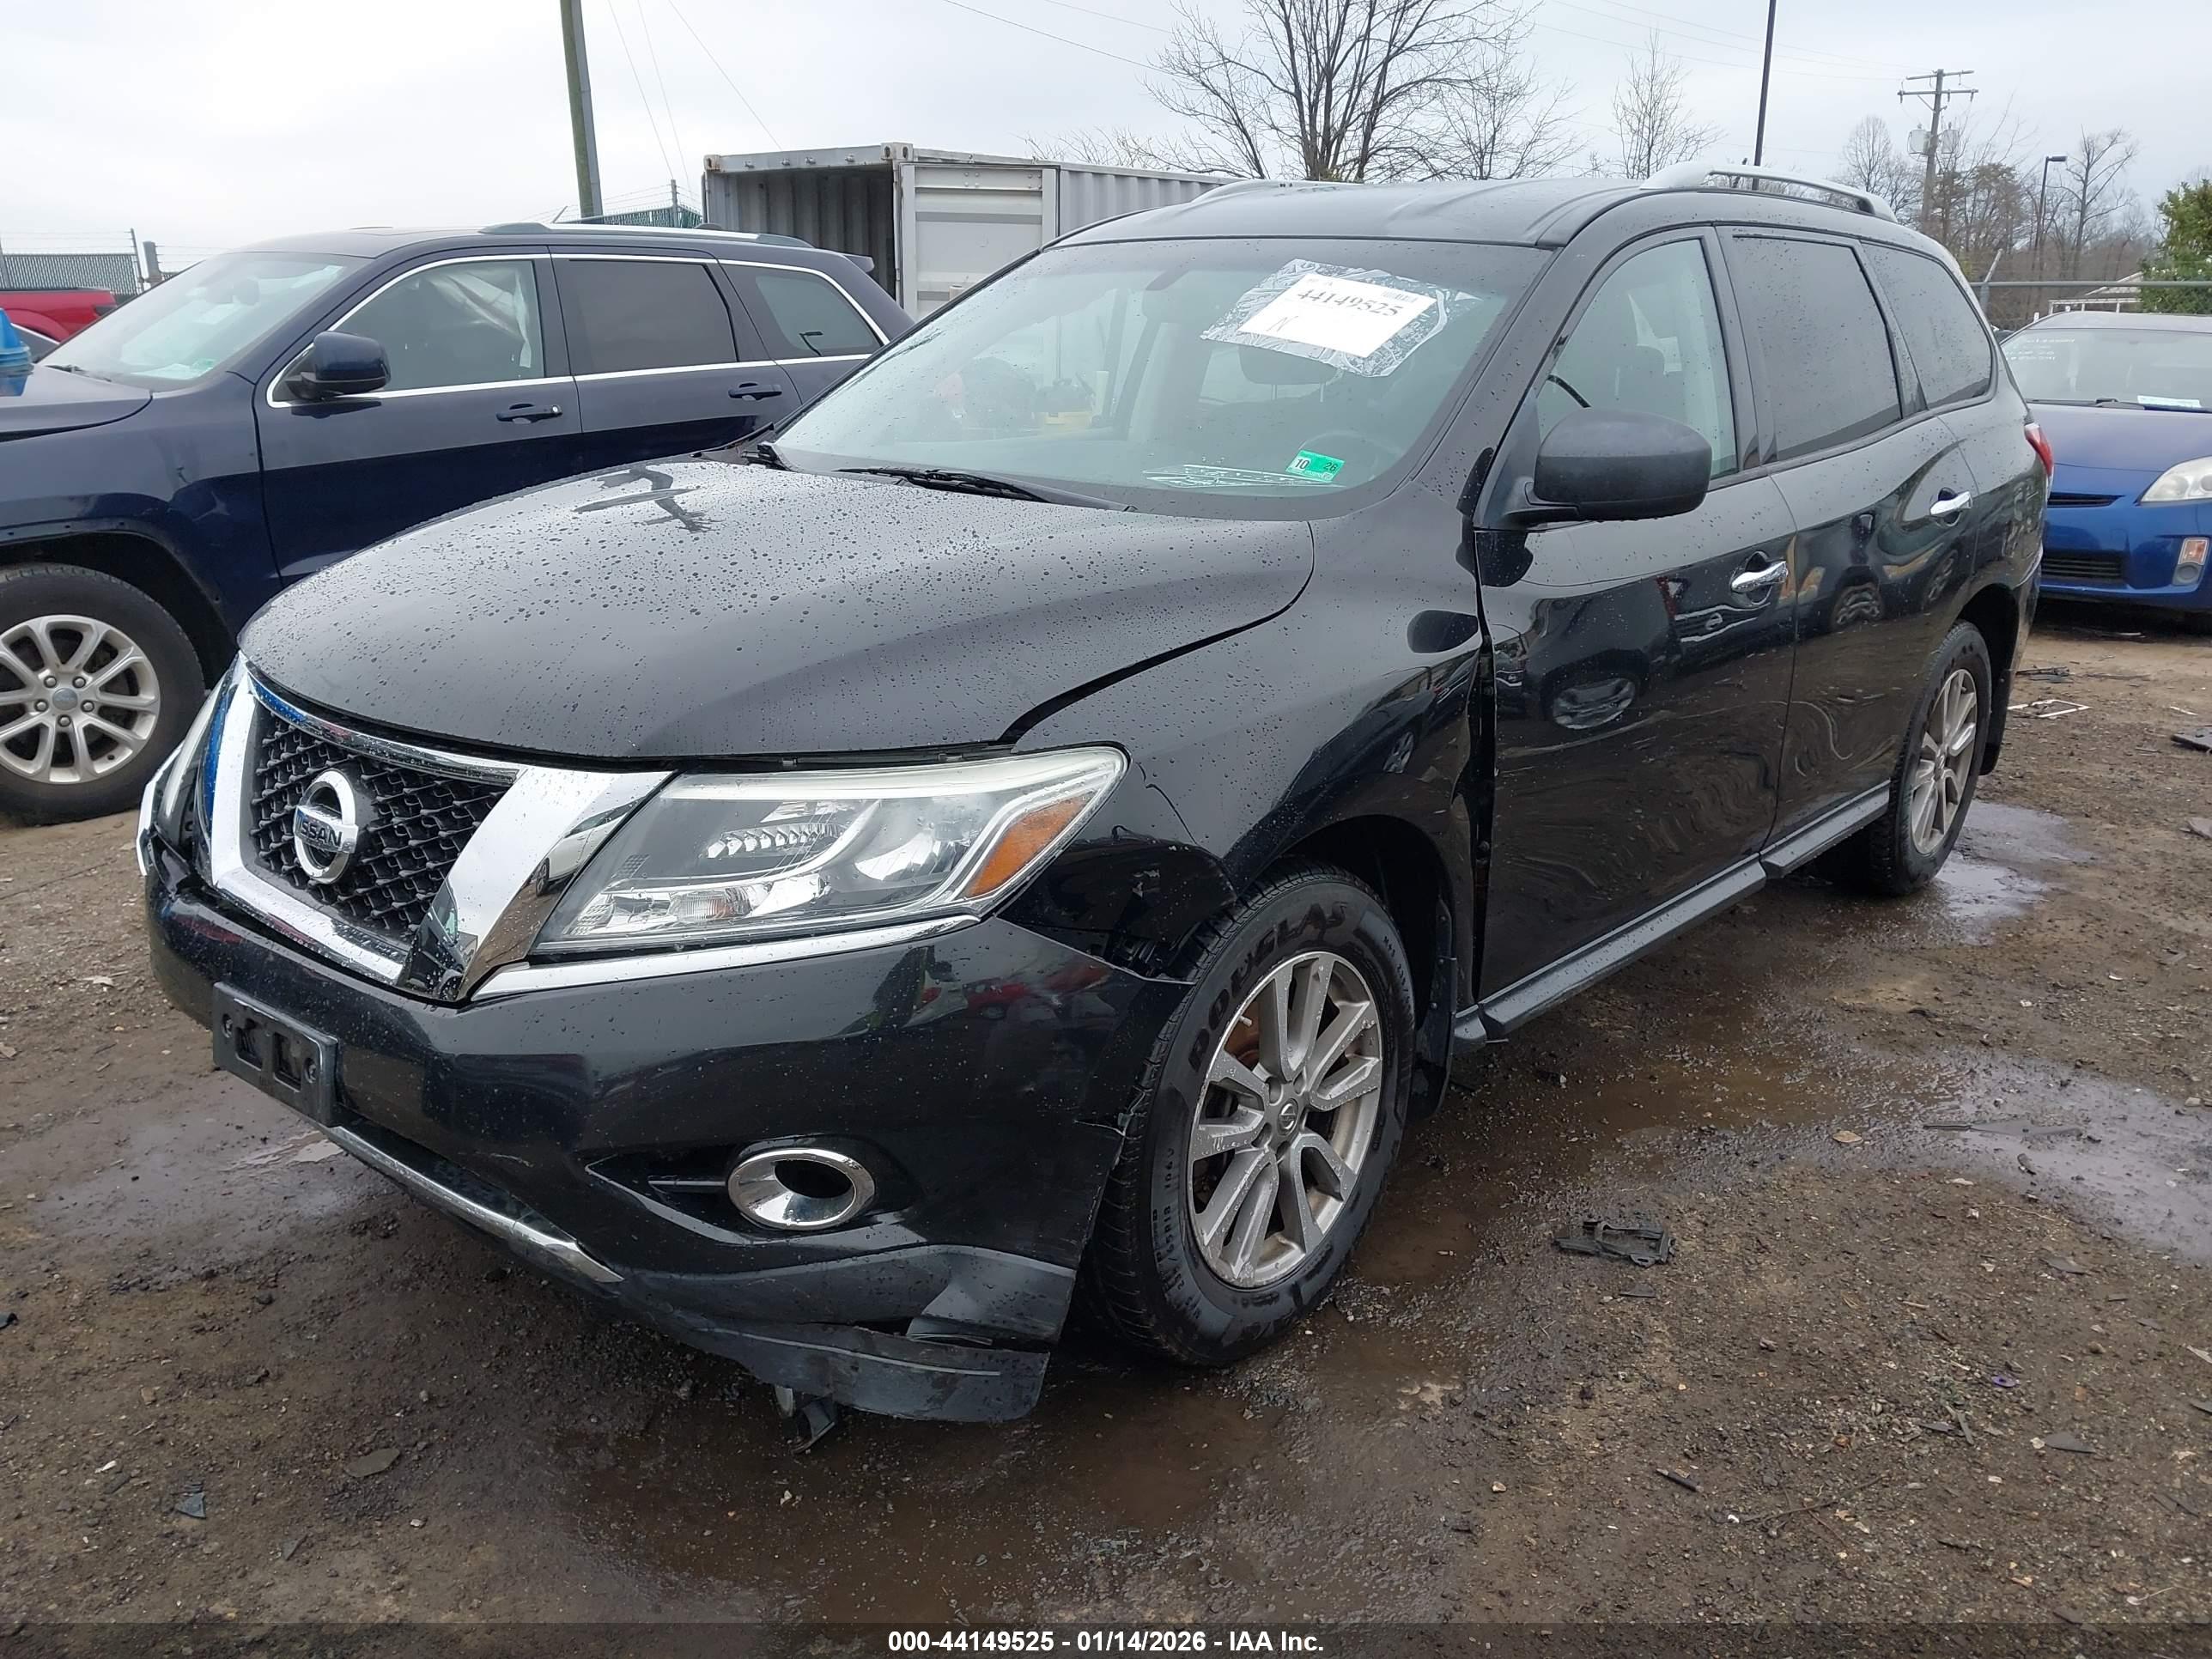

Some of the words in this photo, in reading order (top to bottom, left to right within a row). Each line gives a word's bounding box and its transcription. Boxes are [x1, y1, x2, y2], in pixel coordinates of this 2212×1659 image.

[1297, 289, 1404, 318] 44149525
[1295, 458, 1310, 470] 10
[1323, 461, 1339, 471] 26
[1188, 901, 1347, 1073] DOUGLAS
